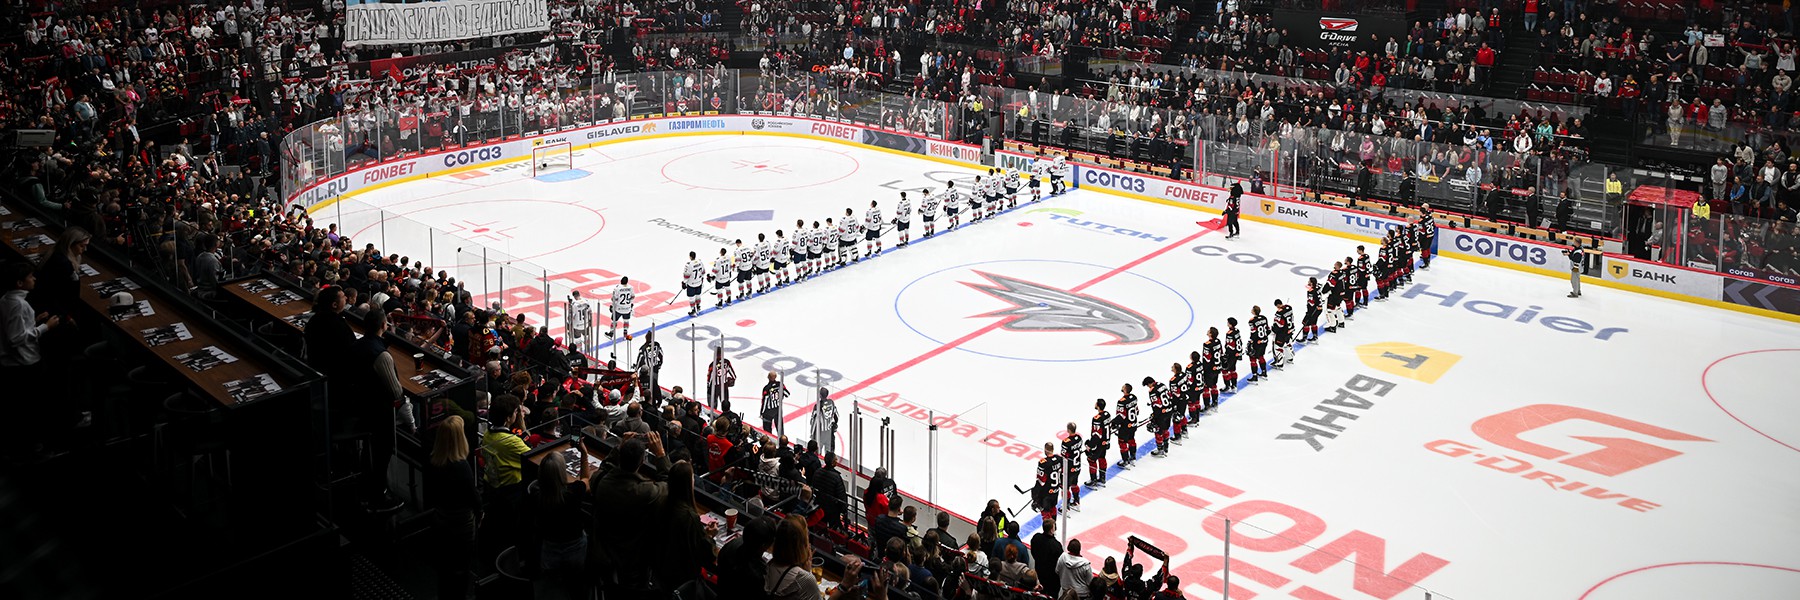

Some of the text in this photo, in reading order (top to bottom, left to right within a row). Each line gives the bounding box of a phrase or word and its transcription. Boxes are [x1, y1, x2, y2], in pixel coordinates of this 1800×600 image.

[346, 0, 545, 41] НАША СИЛА В ЕДИНСТВЕ
[1320, 31, 1357, 42] G-DRIVE
[456, 57, 496, 70] LTRAS
[587, 125, 640, 140] GISLAVED
[668, 120, 726, 131] ГАЗПРОМНЕФТЬ
[811, 122, 858, 140] FONBET
[363, 162, 417, 184] FONBET
[1001, 154, 1033, 173] МИ
[1165, 185, 1219, 204] FONBET
[1277, 206, 1308, 219] БАНК
[1191, 245, 1333, 280] сога
[1632, 268, 1677, 285] БАНК
[1402, 283, 1630, 342] Haier
[1275, 374, 1398, 453] БАНК
[865, 392, 1046, 461] Альфа Бан
[1115, 474, 1451, 600] FON
